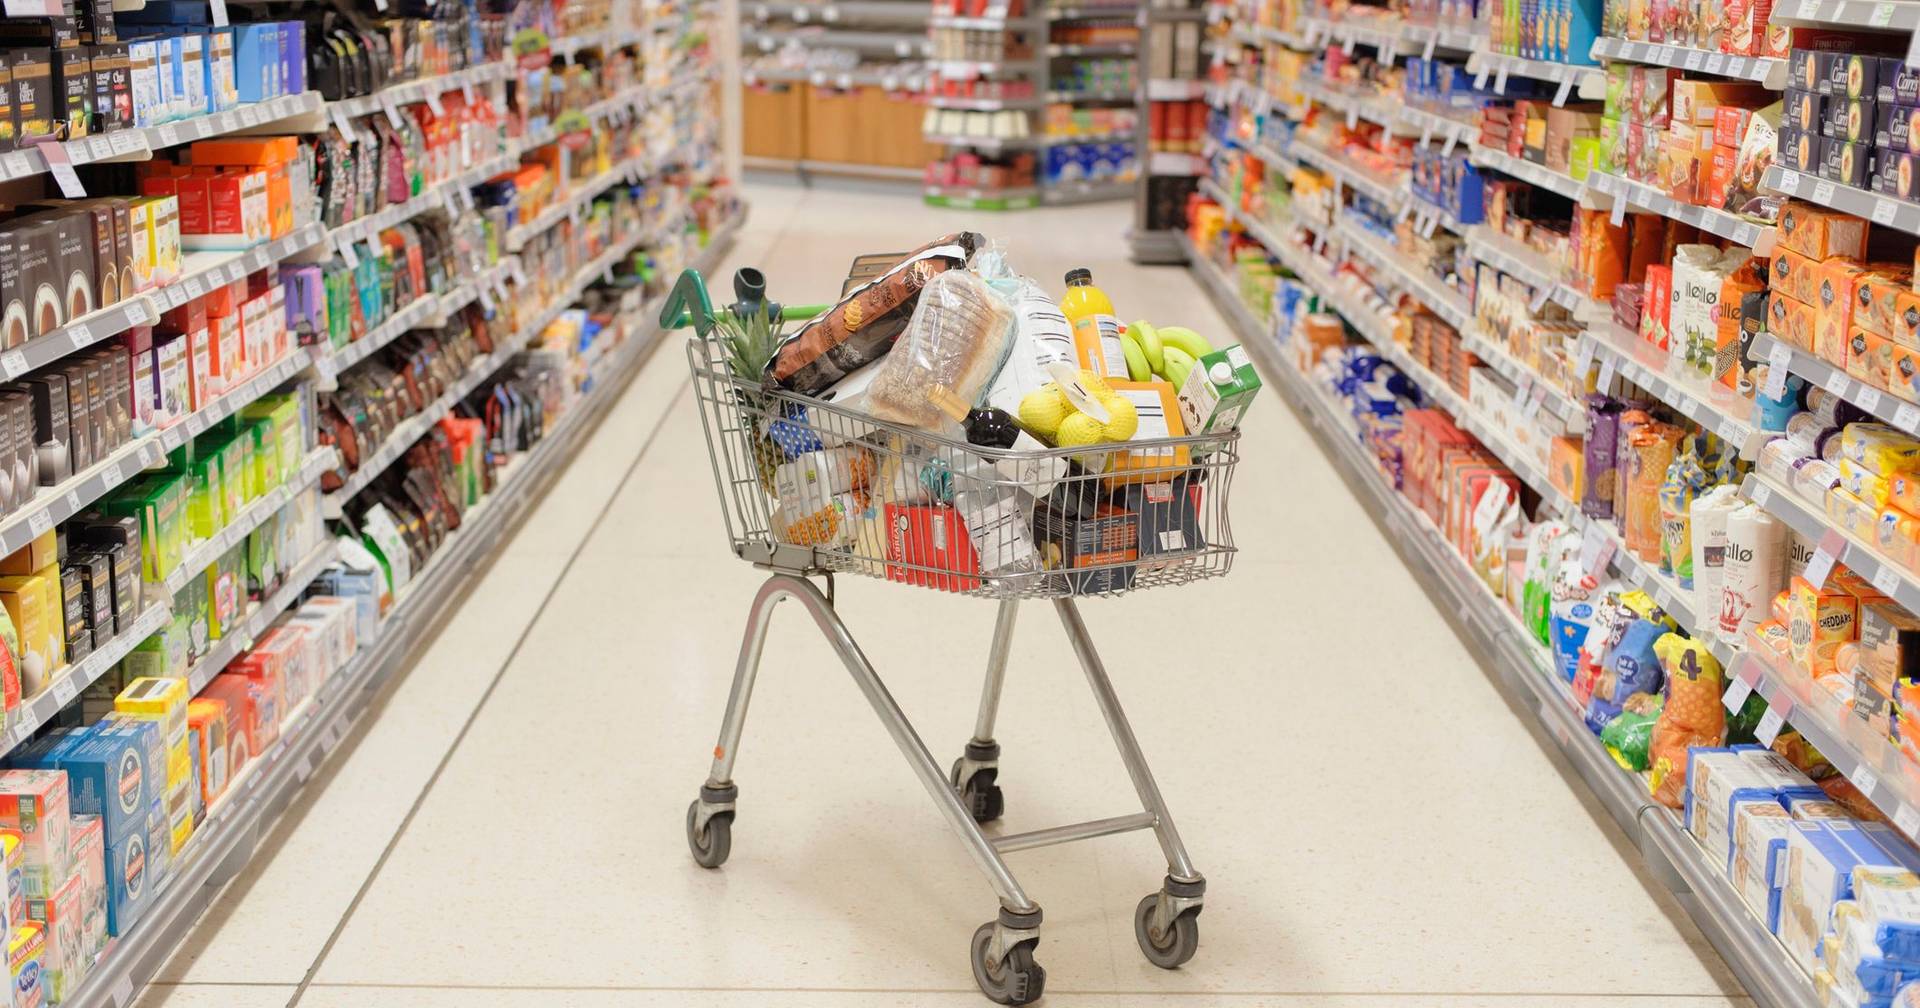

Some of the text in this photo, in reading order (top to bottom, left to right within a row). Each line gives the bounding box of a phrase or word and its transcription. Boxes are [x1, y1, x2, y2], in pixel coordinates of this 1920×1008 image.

[1725, 541, 1753, 563] allø
[1818, 612, 1852, 629] CHEDDARS
[1679, 648, 1703, 681] 4
